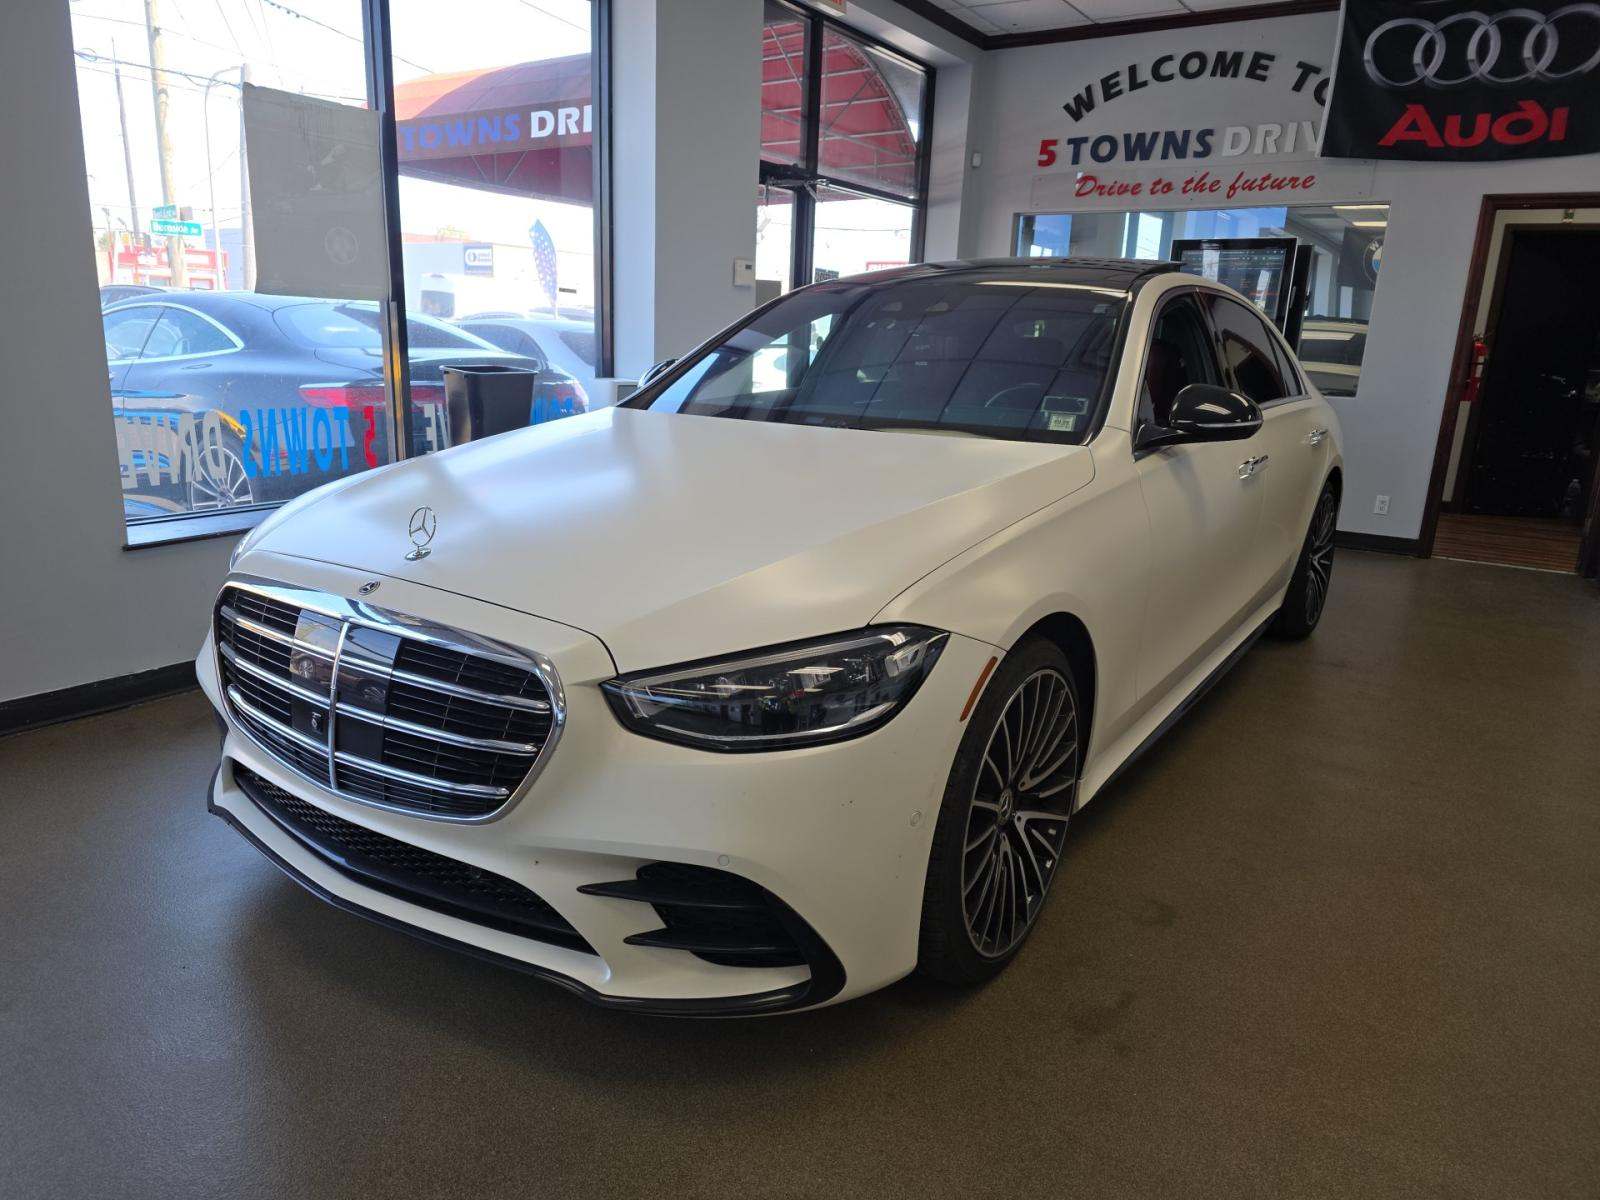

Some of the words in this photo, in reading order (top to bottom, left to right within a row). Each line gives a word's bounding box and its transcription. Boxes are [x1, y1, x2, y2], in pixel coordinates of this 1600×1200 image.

[1063, 51, 1275, 122] WELCOME
[400, 113, 521, 152] TOWNS
[1377, 100, 1570, 147] Audi
[1038, 139, 1058, 167] 5
[1067, 129, 1215, 165] TOWNS
[1074, 174, 1144, 197] Drive
[1150, 175, 1174, 194] to
[1182, 172, 1222, 194] the
[1226, 171, 1316, 199] future
